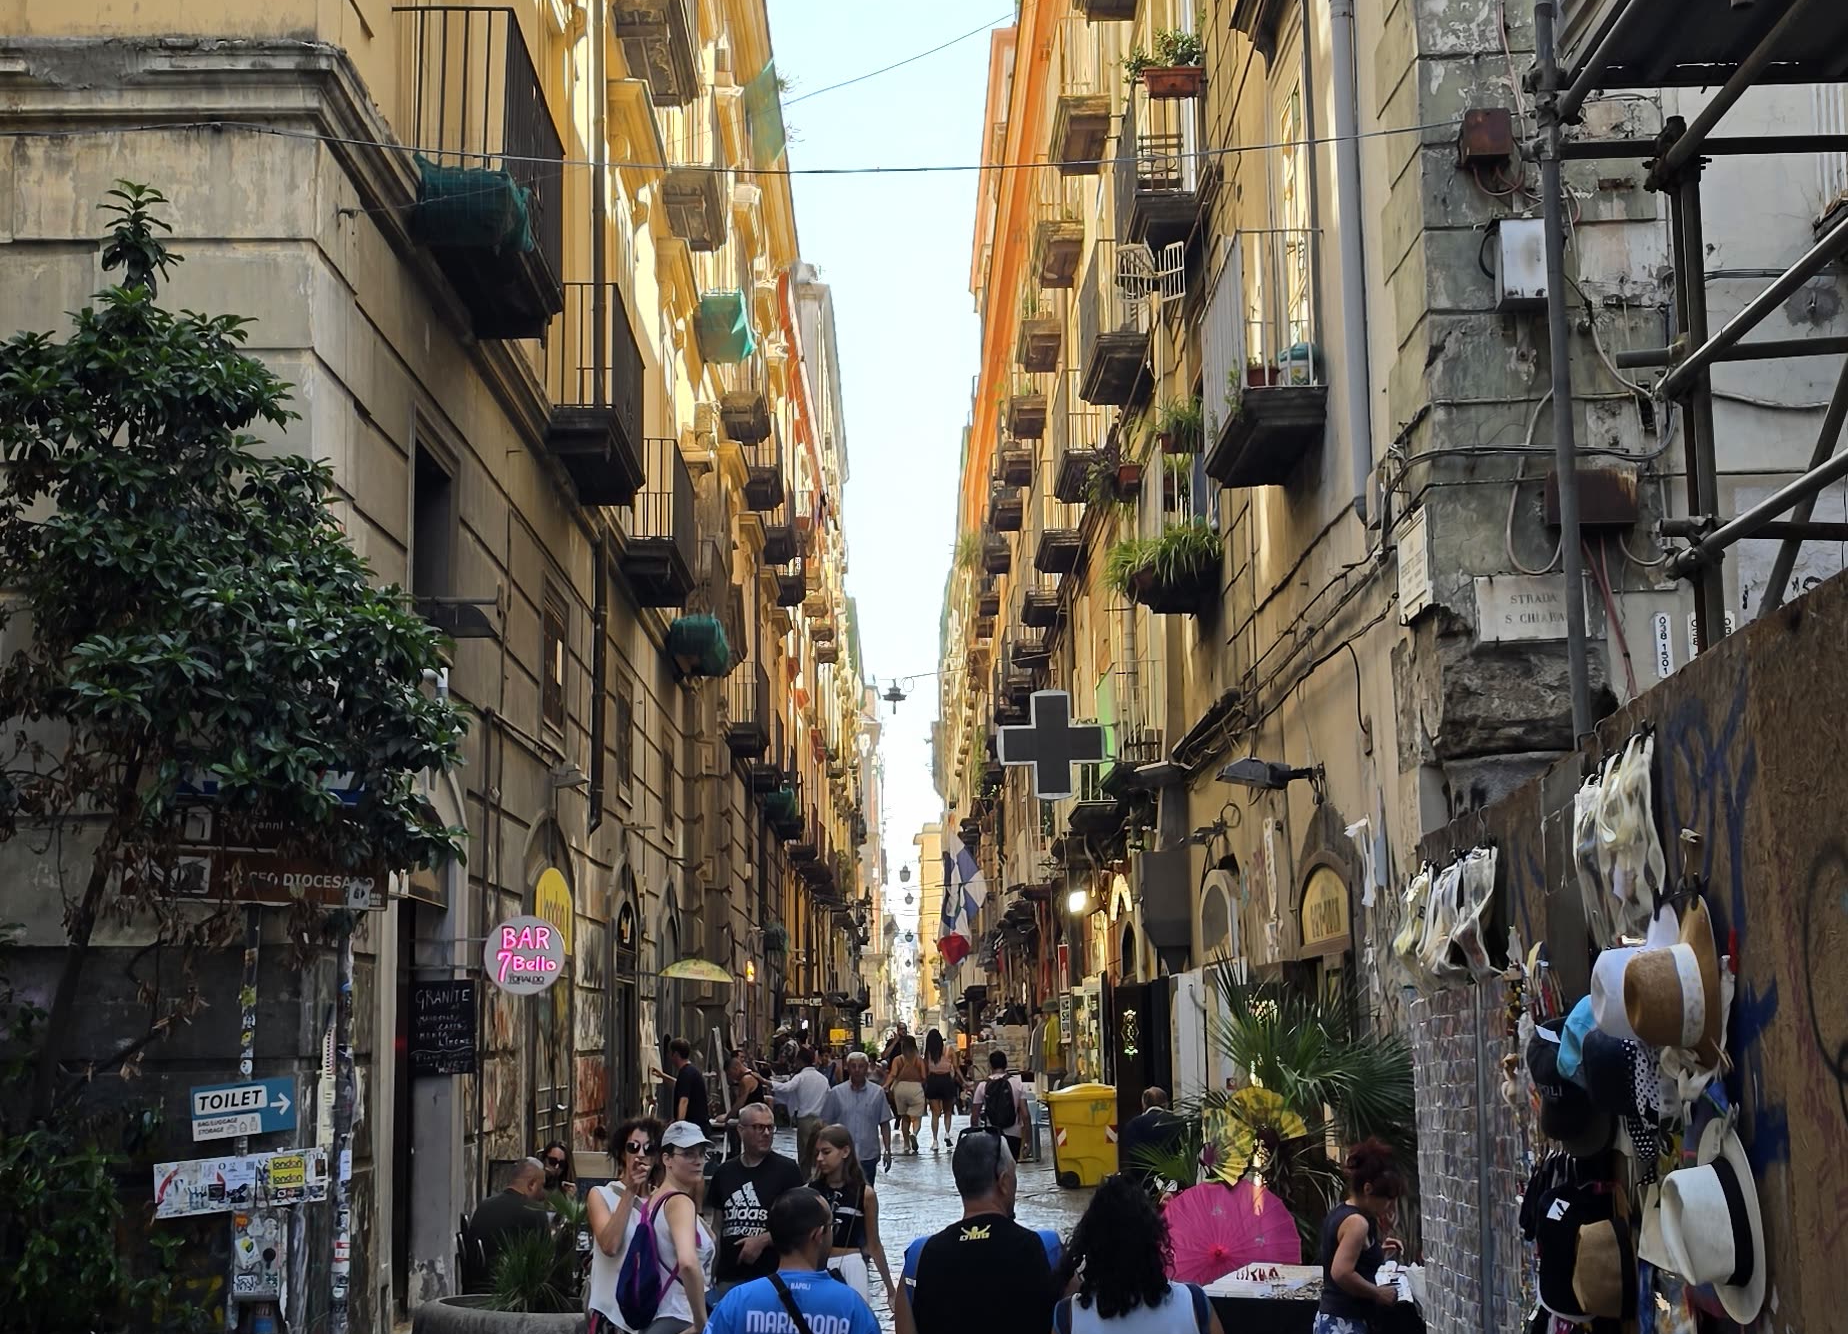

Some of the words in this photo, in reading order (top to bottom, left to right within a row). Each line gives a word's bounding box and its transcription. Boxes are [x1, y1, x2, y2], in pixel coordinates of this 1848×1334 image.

[1510, 593, 1558, 604] STRADA
[1661, 644, 1669, 675] 1501
[283, 872, 375, 889] DIOCESAO
[502, 925, 551, 950] BAR
[415, 988, 471, 1010] GRANITE
[198, 1089, 263, 1111] TOILET
[197, 1126, 224, 1136] STORAGE
[272, 1159, 303, 1170] london
[272, 1174, 303, 1185] london
